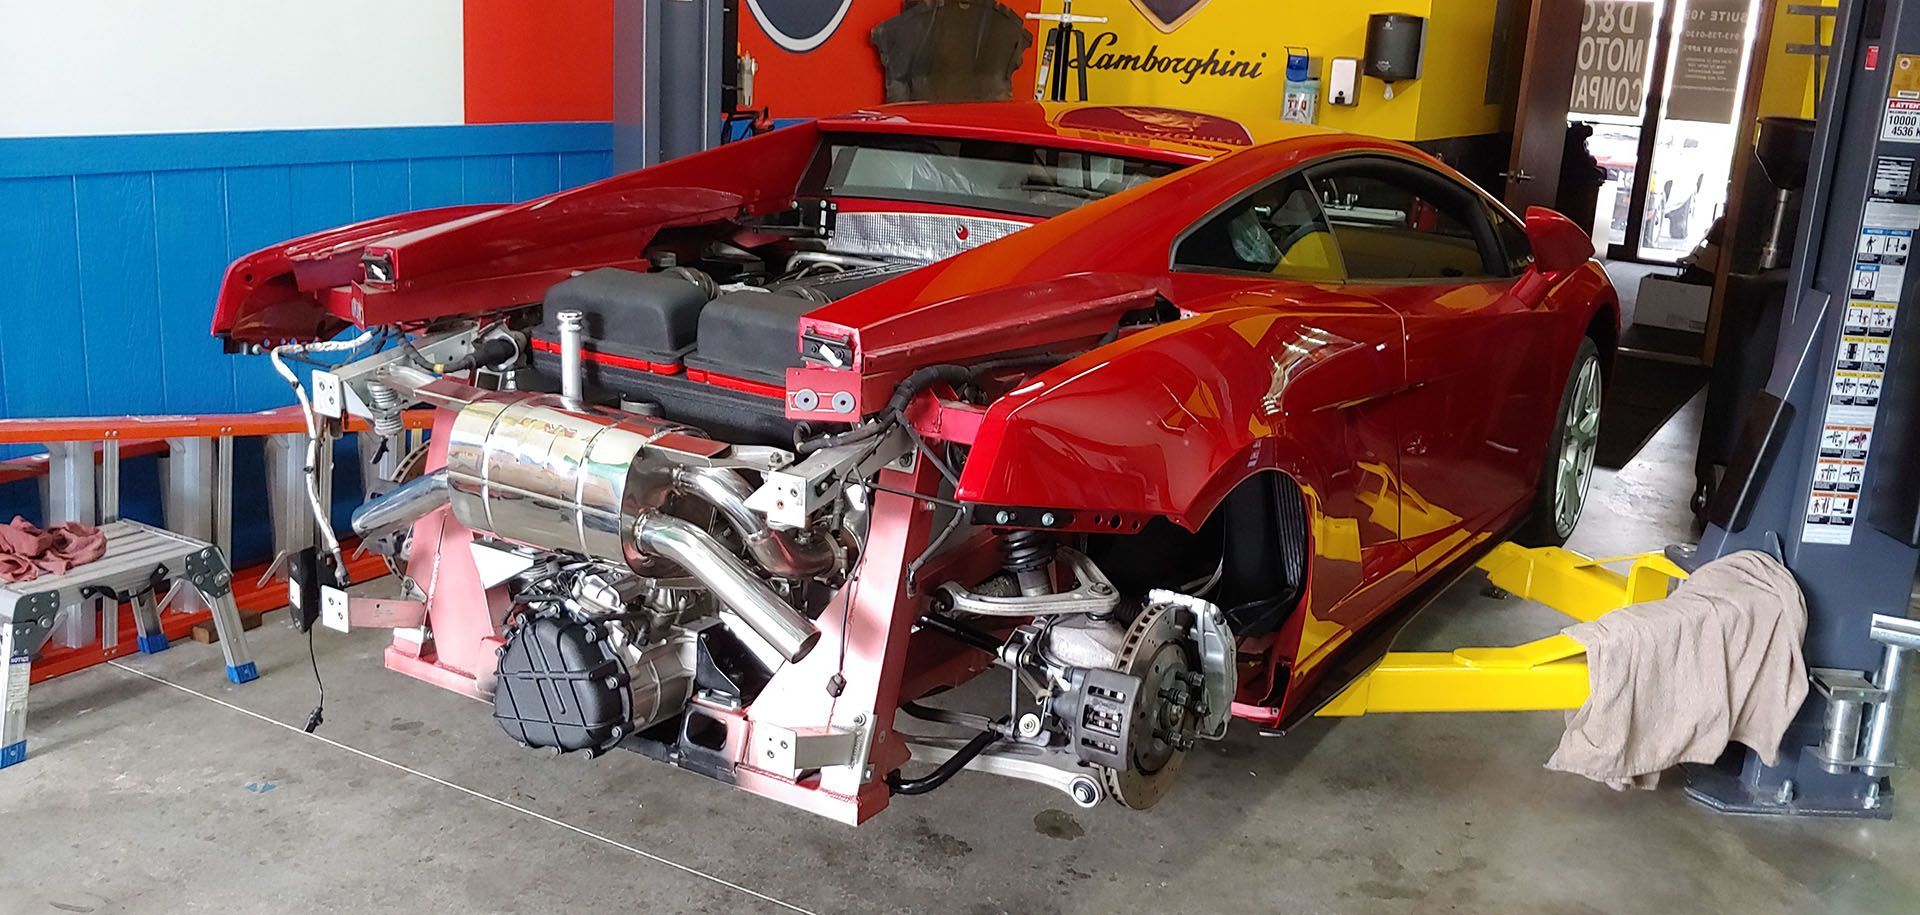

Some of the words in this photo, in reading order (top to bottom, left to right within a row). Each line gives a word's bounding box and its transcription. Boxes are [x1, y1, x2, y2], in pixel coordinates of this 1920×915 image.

[1069, 32, 1267, 84] Lamborghini
[1889, 115, 1917, 126] 10000
[1891, 126, 1914, 137] 4536
